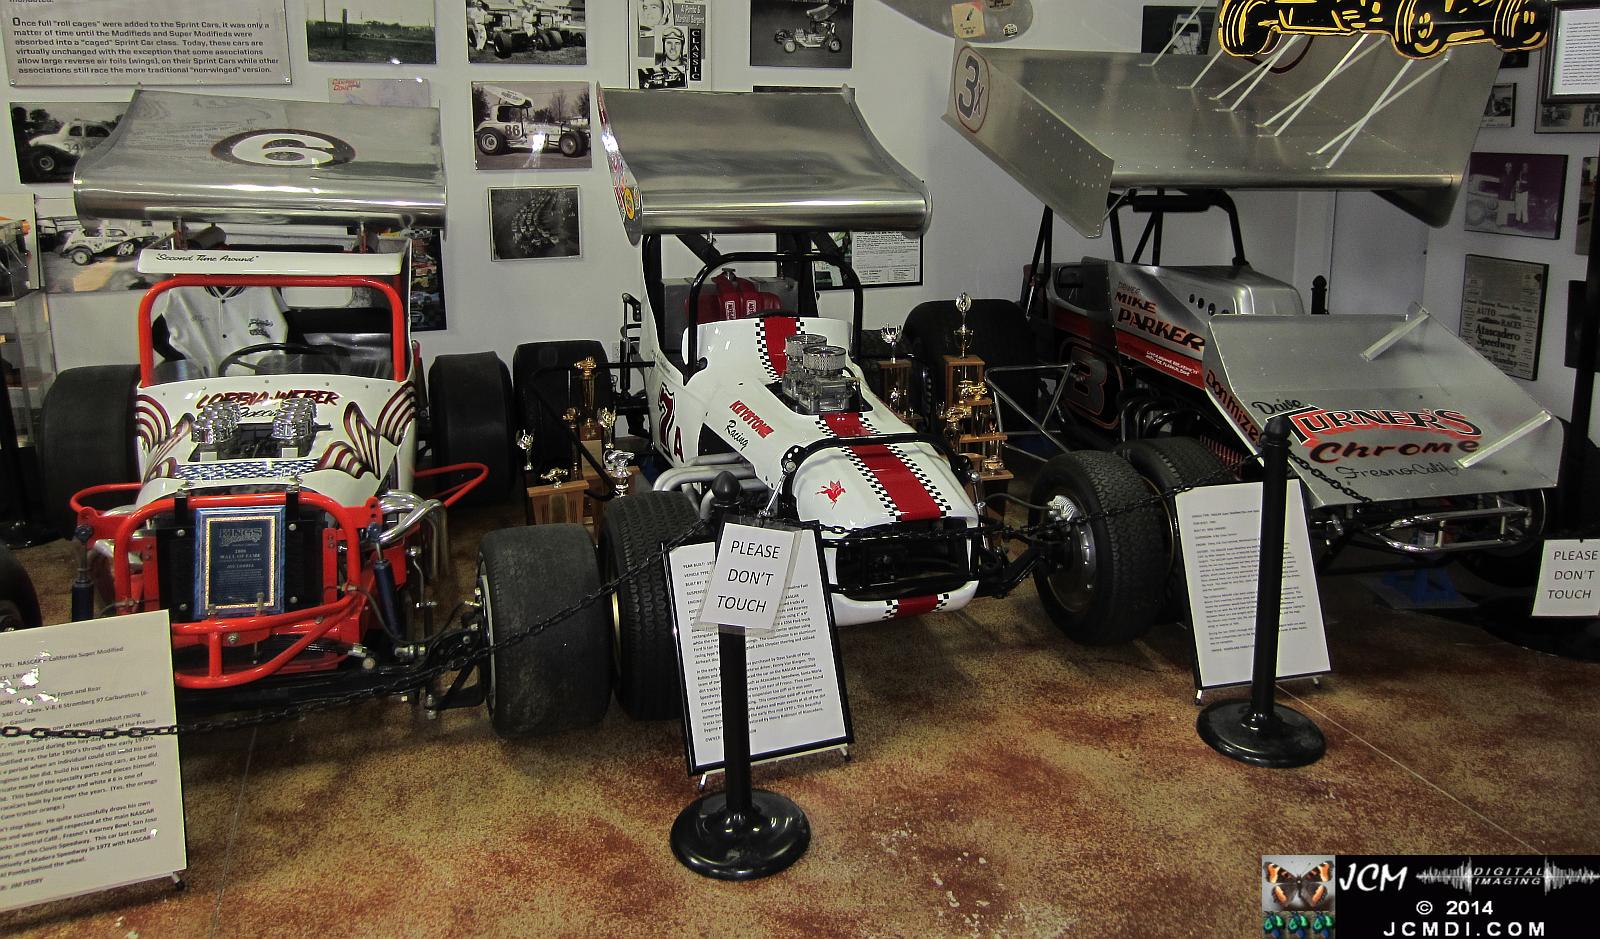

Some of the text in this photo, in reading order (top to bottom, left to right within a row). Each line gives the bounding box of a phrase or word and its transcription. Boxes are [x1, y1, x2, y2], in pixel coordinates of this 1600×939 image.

[12, 18, 36, 27] Once
[81, 39, 112, 47] "caged"
[133, 49, 172, 57] exception
[691, 30, 700, 80] CLASSIC
[41, 58, 62, 66] large
[504, 125, 520, 136] 86
[232, 133, 335, 165] 6
[197, 254, 216, 262] Time
[1114, 292, 1156, 314] MIKE
[1476, 308, 1496, 317] AUTO
[1116, 308, 1205, 352] PARKER
[1477, 334, 1516, 352] Speedway
[1206, 370, 1228, 404] Don
[1252, 398, 1304, 415] Dave
[729, 400, 774, 439] KEYSTONE
[1266, 404, 1484, 446] TURNER'S
[724, 420, 750, 451] Racing
[1310, 439, 1480, 464] Chrome
[731, 540, 780, 559] PLEASE
[1554, 550, 1598, 560] PLEASE
[728, 568, 774, 586] DON'T
[1554, 570, 1595, 580] DON'T
[1548, 590, 1592, 600] TOUCH
[718, 595, 766, 613] TOUCH
[49, 645, 124, 662] California Super Modified
[64, 698, 95, 709] Stromberg
[104, 691, 139, 702] Carburetors
[72, 712, 141, 728] several standout racing
[46, 742, 65, 751] during
[82, 743, 105, 753] through
[118, 739, 133, 747] early
[57, 755, 86, 765] individual
[88, 752, 104, 760] could
[54, 784, 76, 793] orange
[89, 778, 106, 786] white
[64, 819, 94, 830] respected
[130, 808, 154, 817] NASCAR
[73, 804, 126, 820] successfully drove
[89, 824, 114, 835] Kearney
[130, 827, 146, 835] raced
[126, 835, 151, 844] NASCAR
